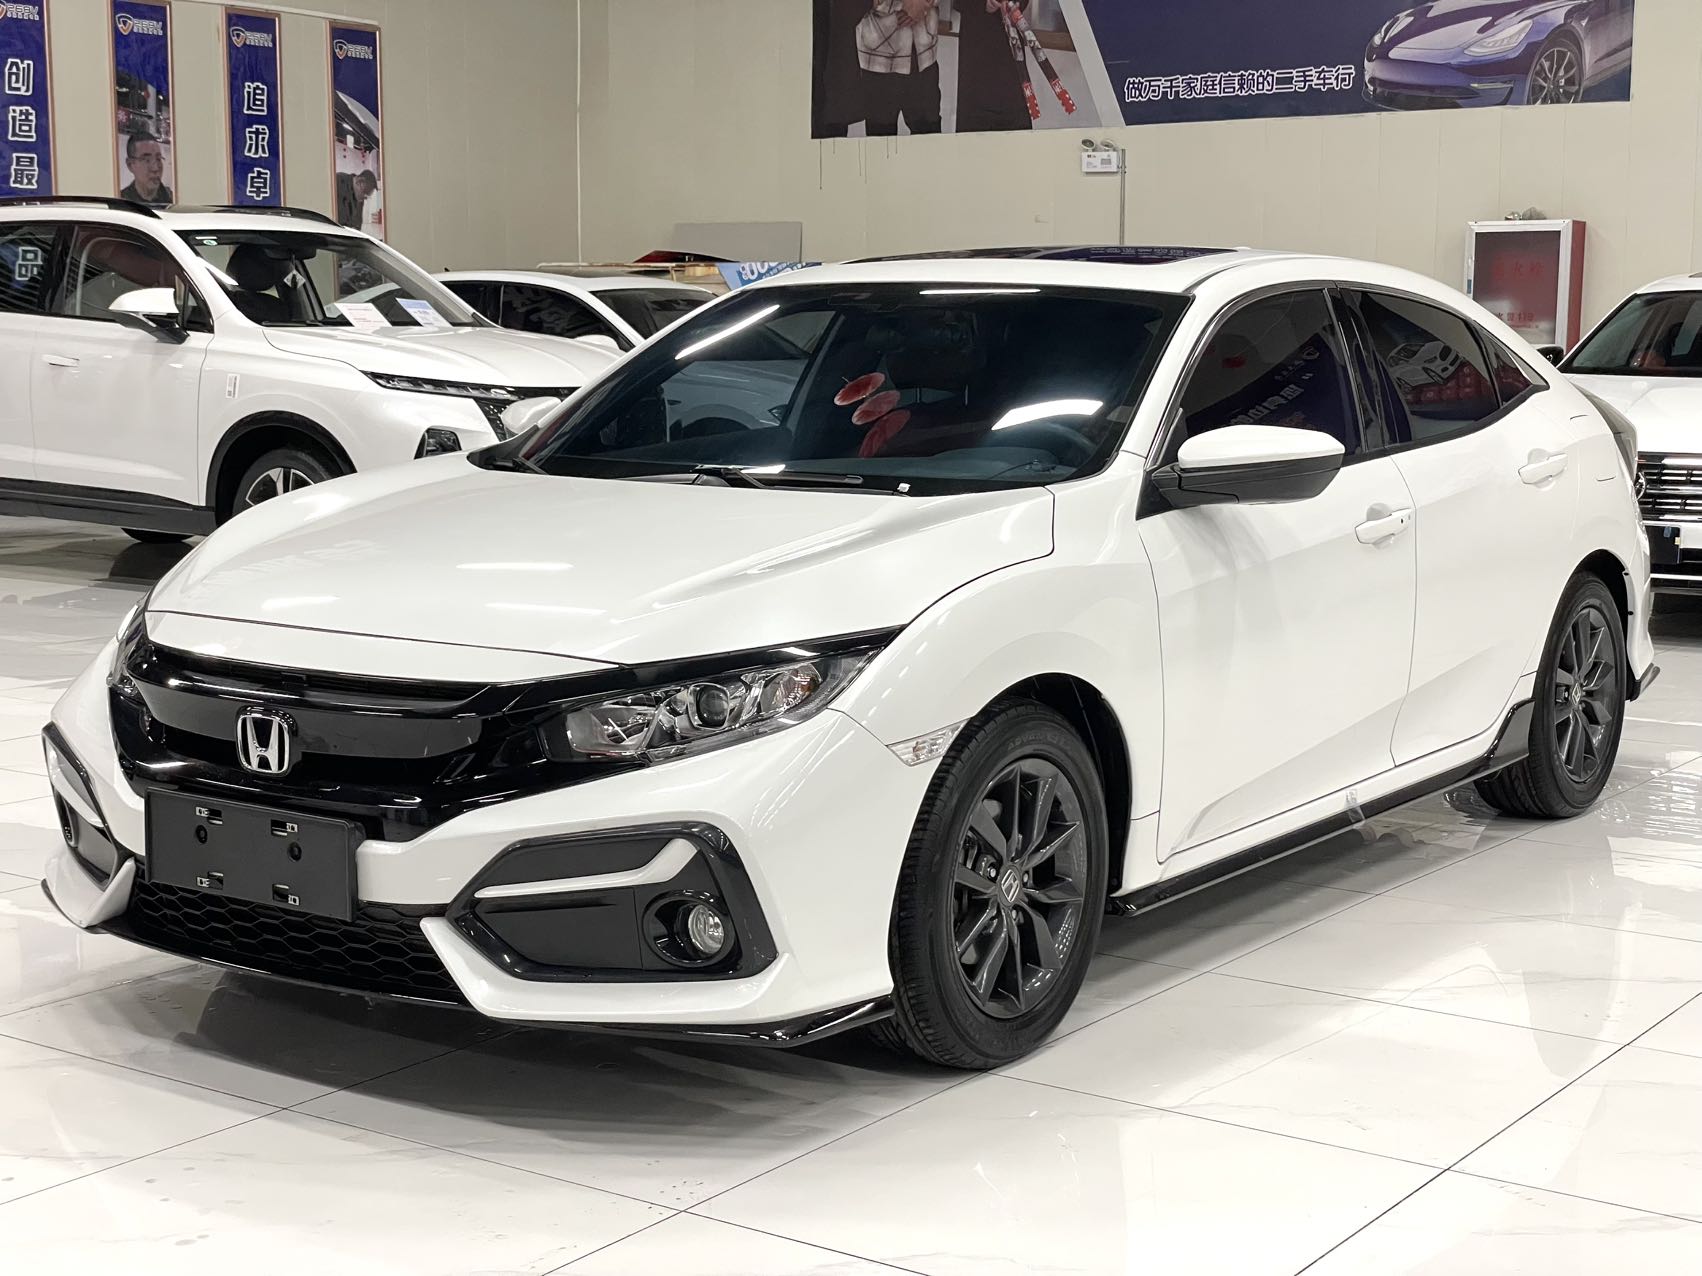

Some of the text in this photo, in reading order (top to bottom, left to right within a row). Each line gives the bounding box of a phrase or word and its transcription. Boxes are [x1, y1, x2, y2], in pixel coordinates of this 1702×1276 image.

[1125, 65, 1354, 102] 做万千家庭信赖的二手车行
